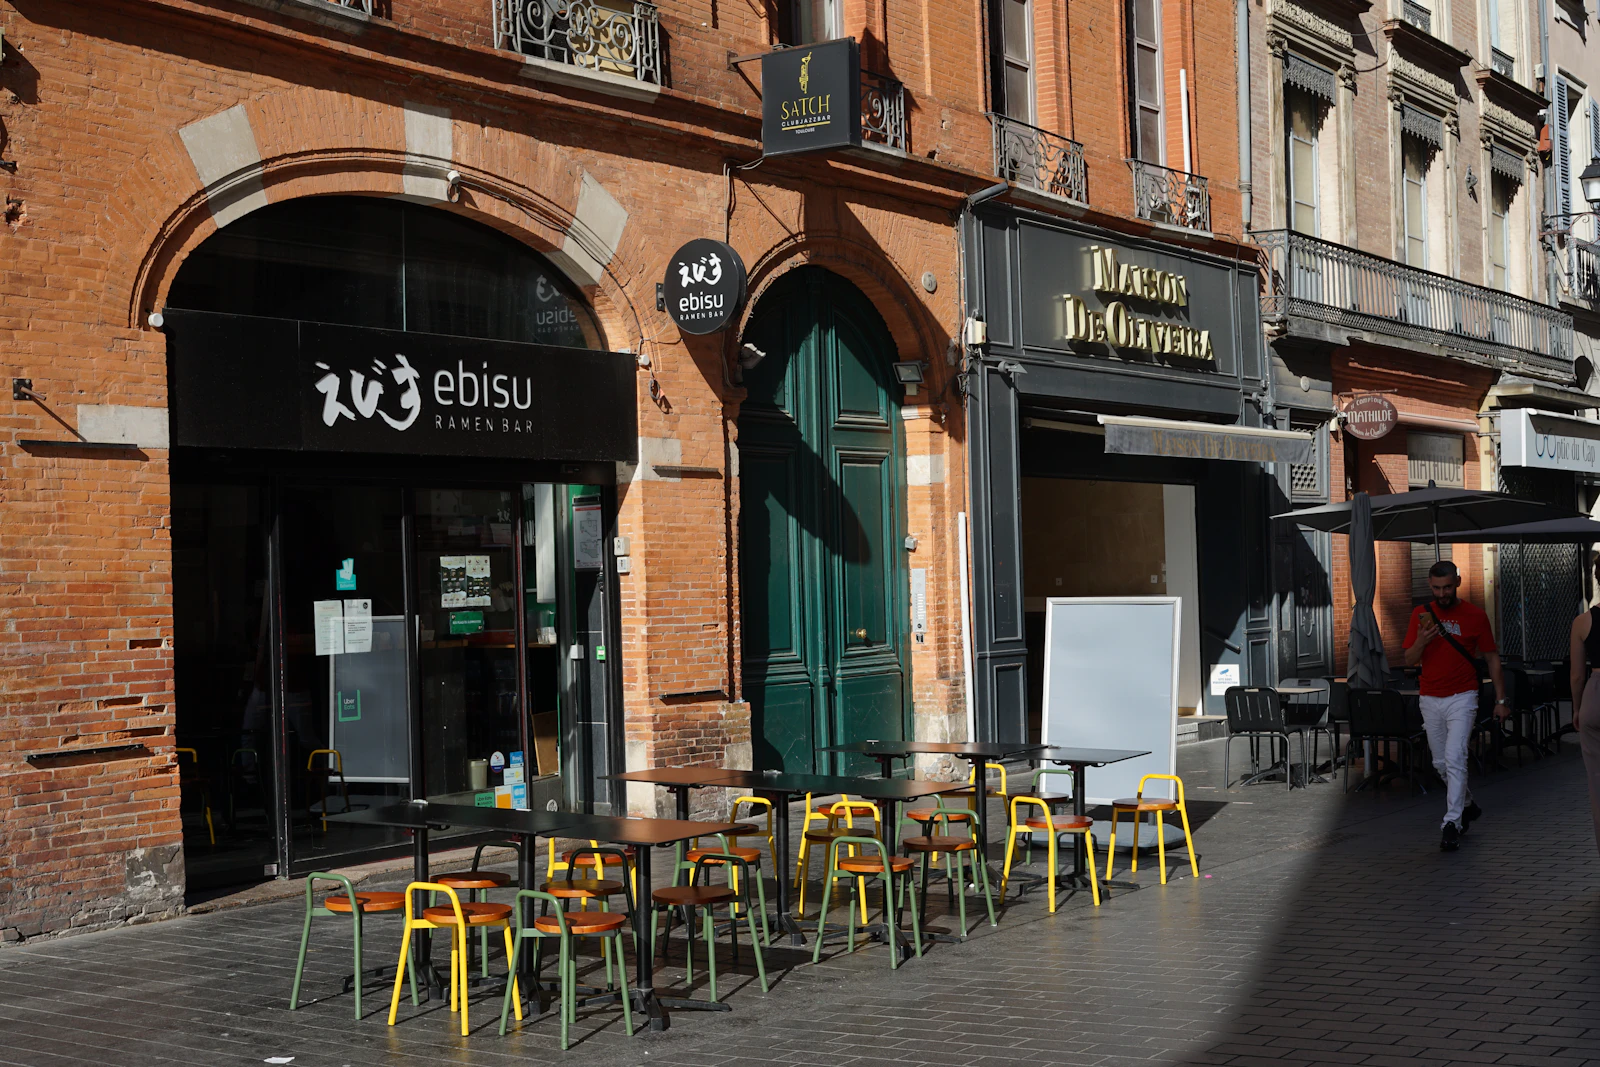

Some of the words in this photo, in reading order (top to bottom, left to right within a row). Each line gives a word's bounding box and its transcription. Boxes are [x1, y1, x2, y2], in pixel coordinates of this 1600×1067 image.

[781, 94, 831, 120] SATCH
[678, 252, 722, 288] えびす
[678, 291, 723, 312] ebisu
[679, 312, 706, 321] RAMEN
[708, 310, 724, 319] BAR
[314, 353, 421, 431] えびす
[433, 359, 533, 410] ebisu
[435, 414, 494, 432] RAMEN
[502, 416, 533, 434] BAR
[1347, 409, 1393, 423] MATHILDE
[1152, 430, 1200, 457] MAISON
[1571, 438, 1580, 461] du
[1582, 439, 1596, 468] Cap
